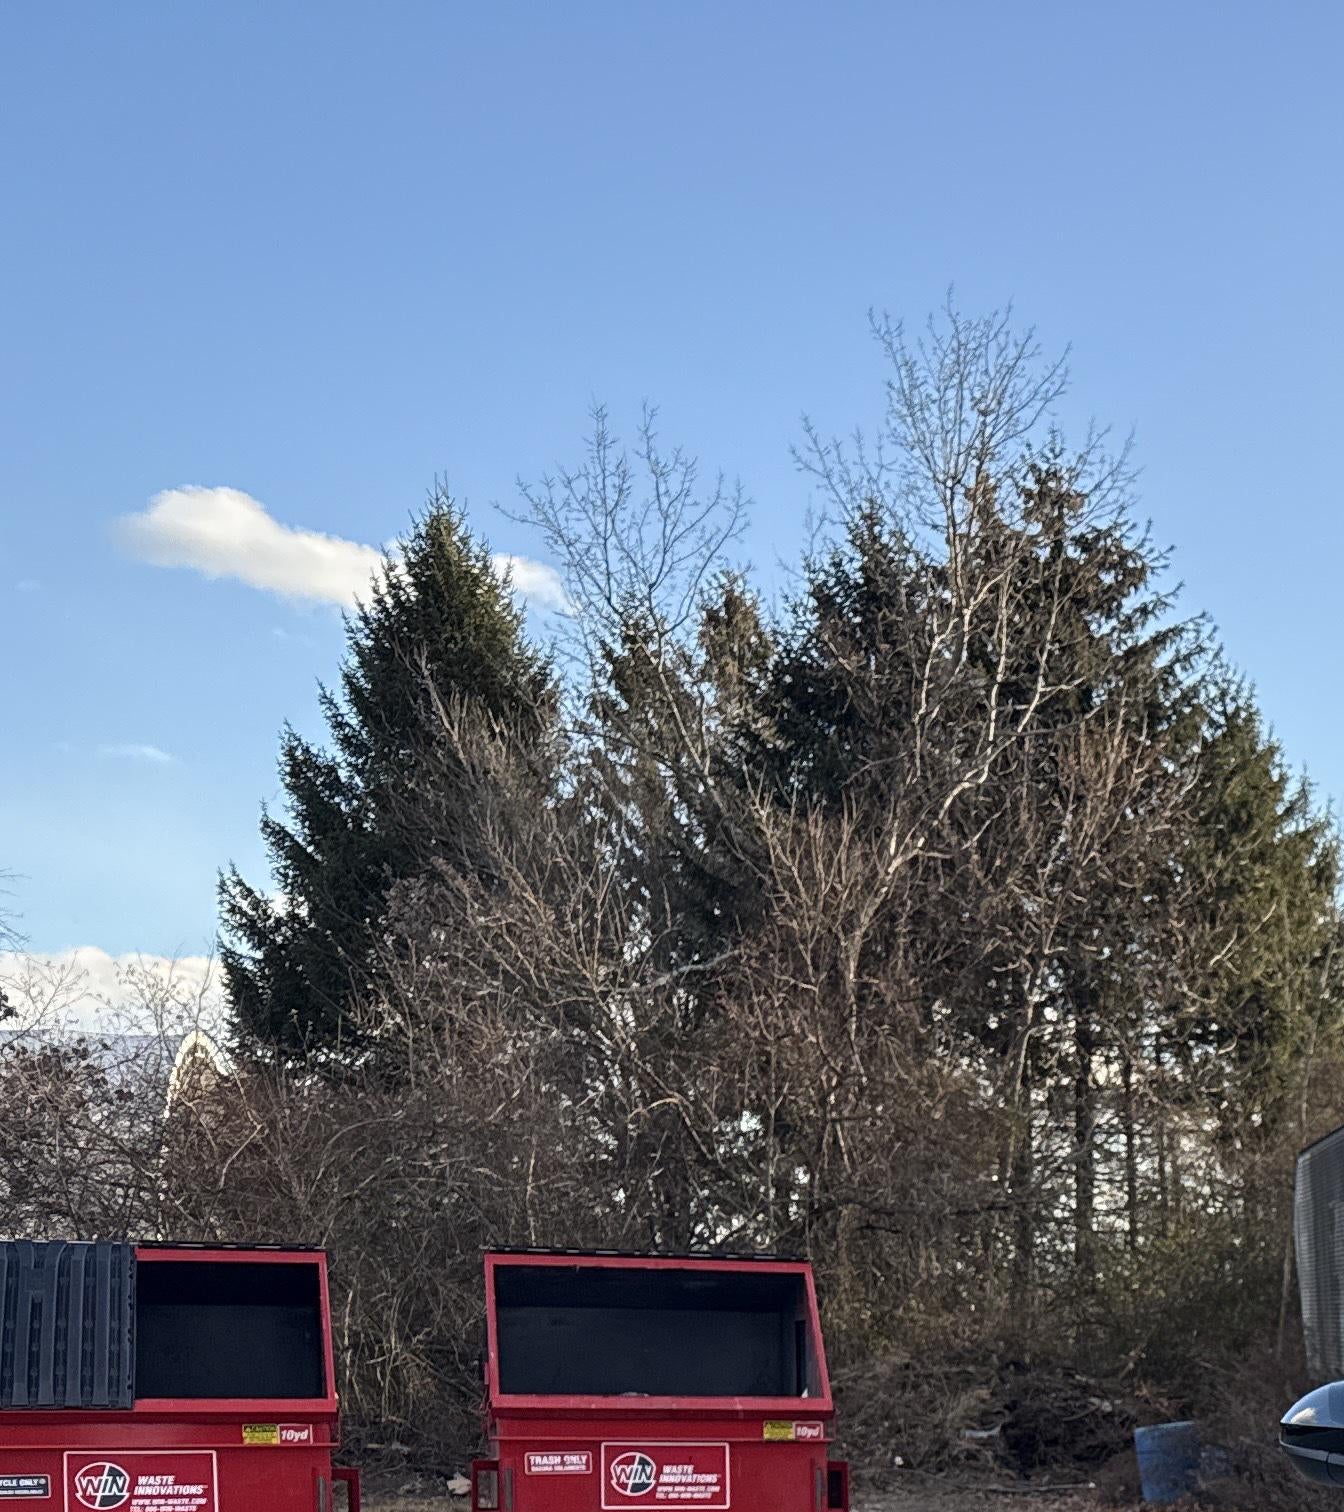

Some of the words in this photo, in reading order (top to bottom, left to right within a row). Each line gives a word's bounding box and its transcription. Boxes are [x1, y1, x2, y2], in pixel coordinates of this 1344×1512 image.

[281, 1429, 309, 1442] 10yd
[529, 1455, 562, 1465] TRASH
[563, 1455, 588, 1465] ONLY
[137, 1475, 176, 1486] WASTE
[133, 1485, 204, 1496] INNOVATIONS
